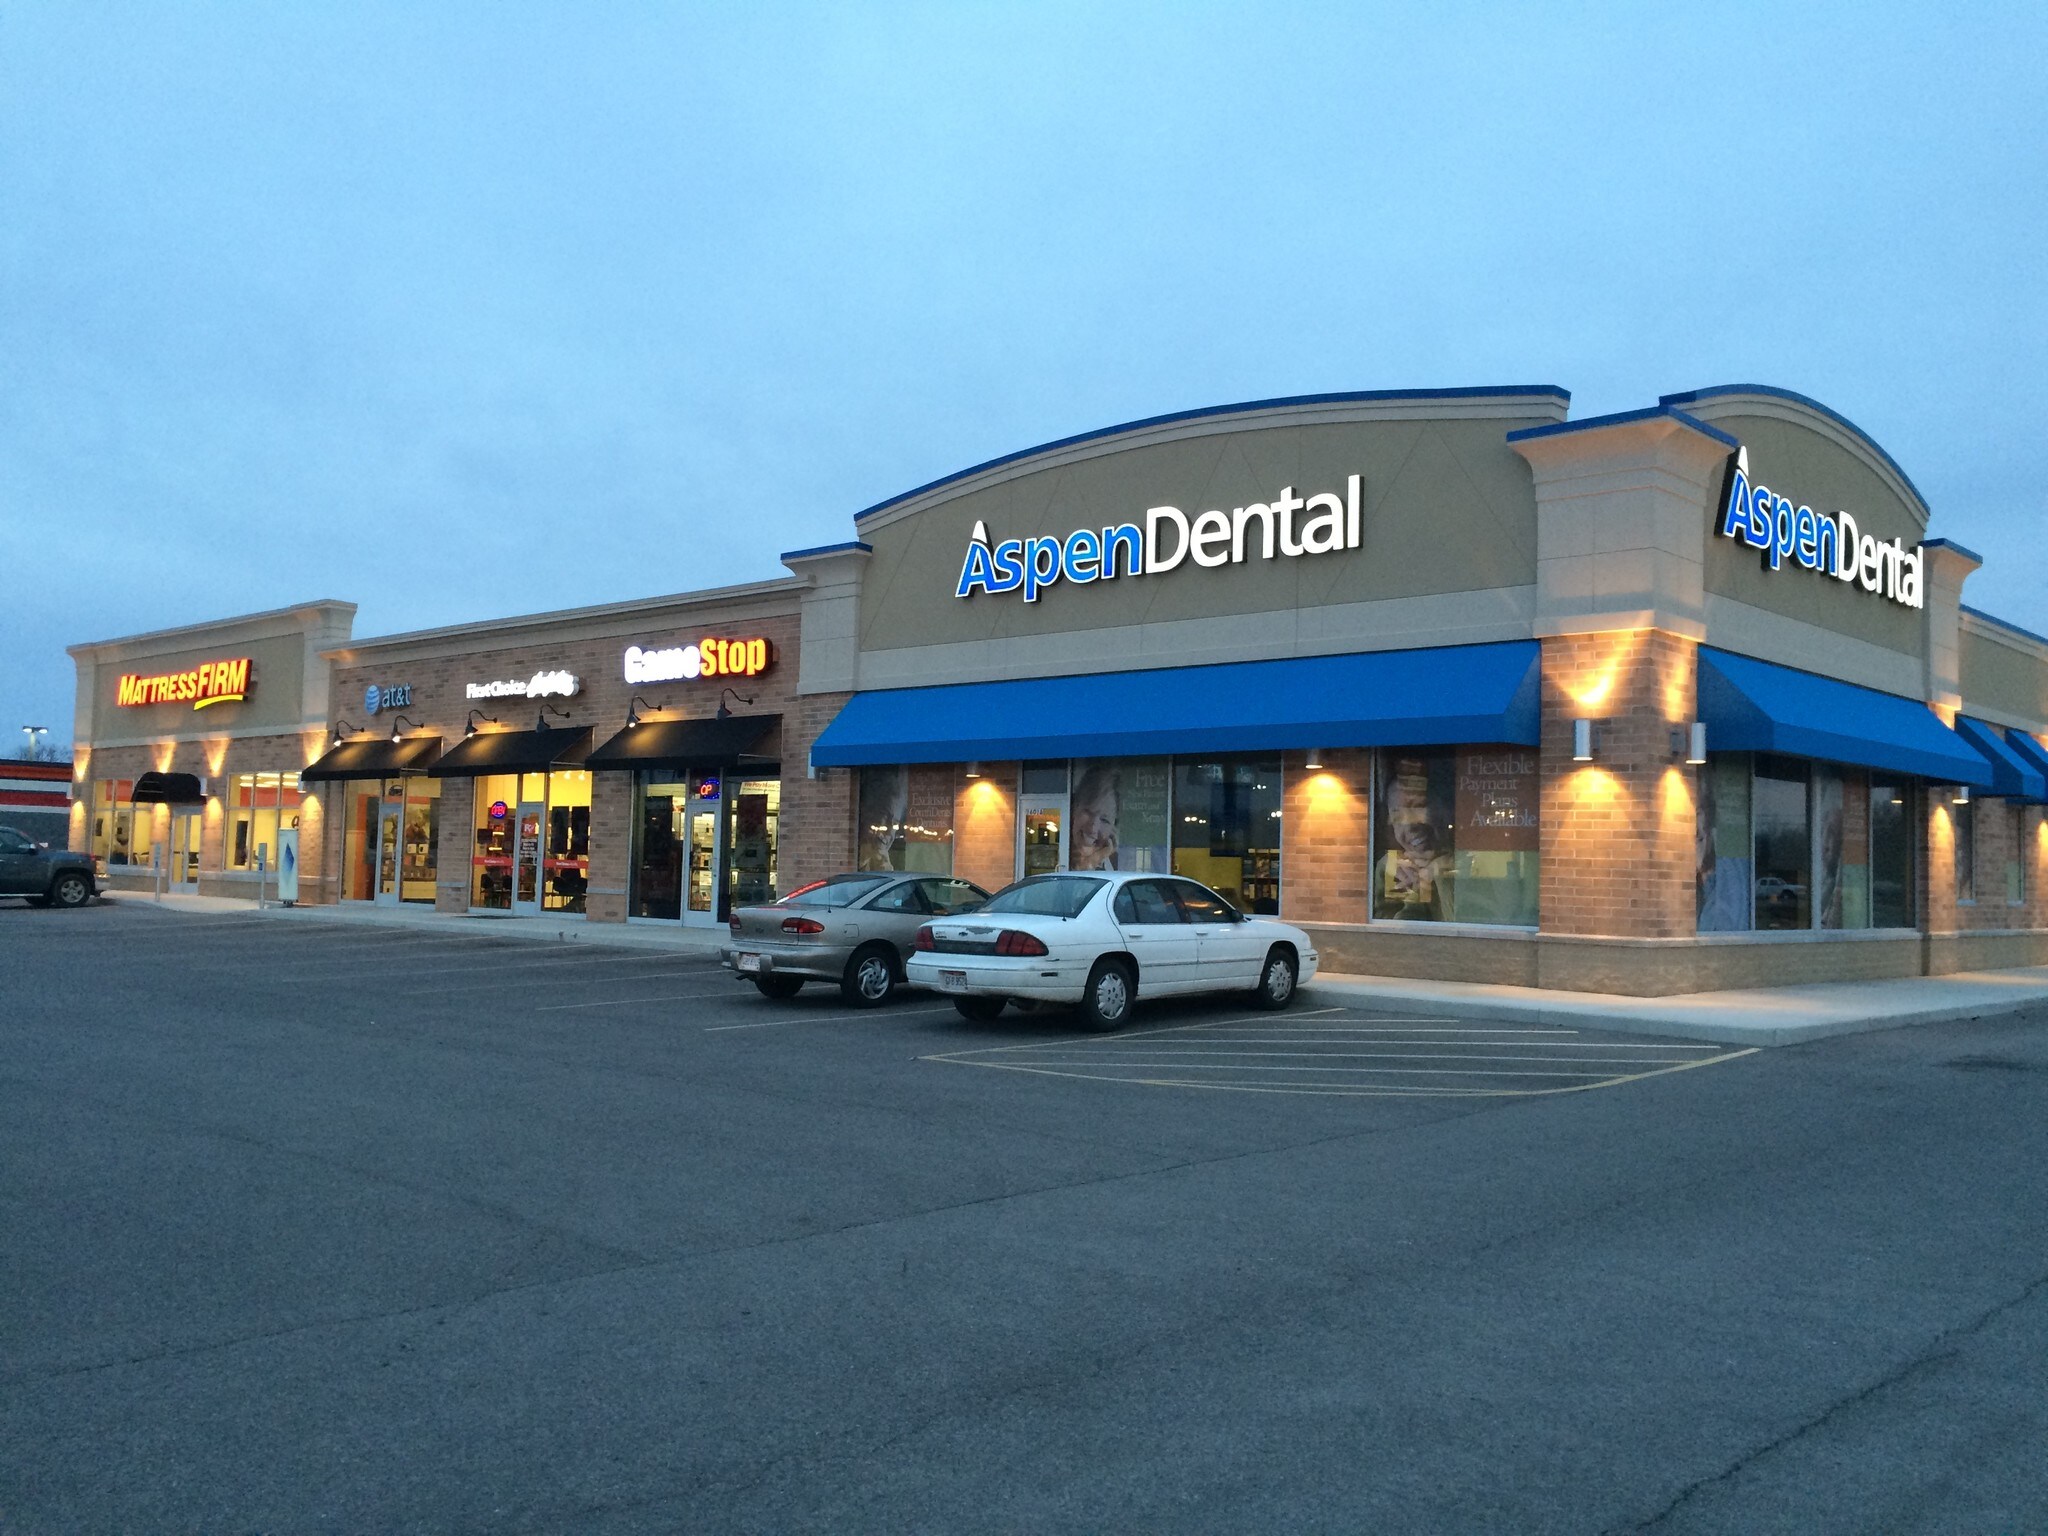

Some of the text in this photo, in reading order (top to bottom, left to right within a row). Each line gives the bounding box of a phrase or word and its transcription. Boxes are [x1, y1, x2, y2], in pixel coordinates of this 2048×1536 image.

[624, 638, 767, 684] GameStop
[382, 682, 411, 708] at&t
[1466, 753, 1535, 775] Flexible
[1460, 776, 1518, 796] Payment
[1482, 792, 1519, 807] Plans
[1470, 808, 1538, 827] Available
